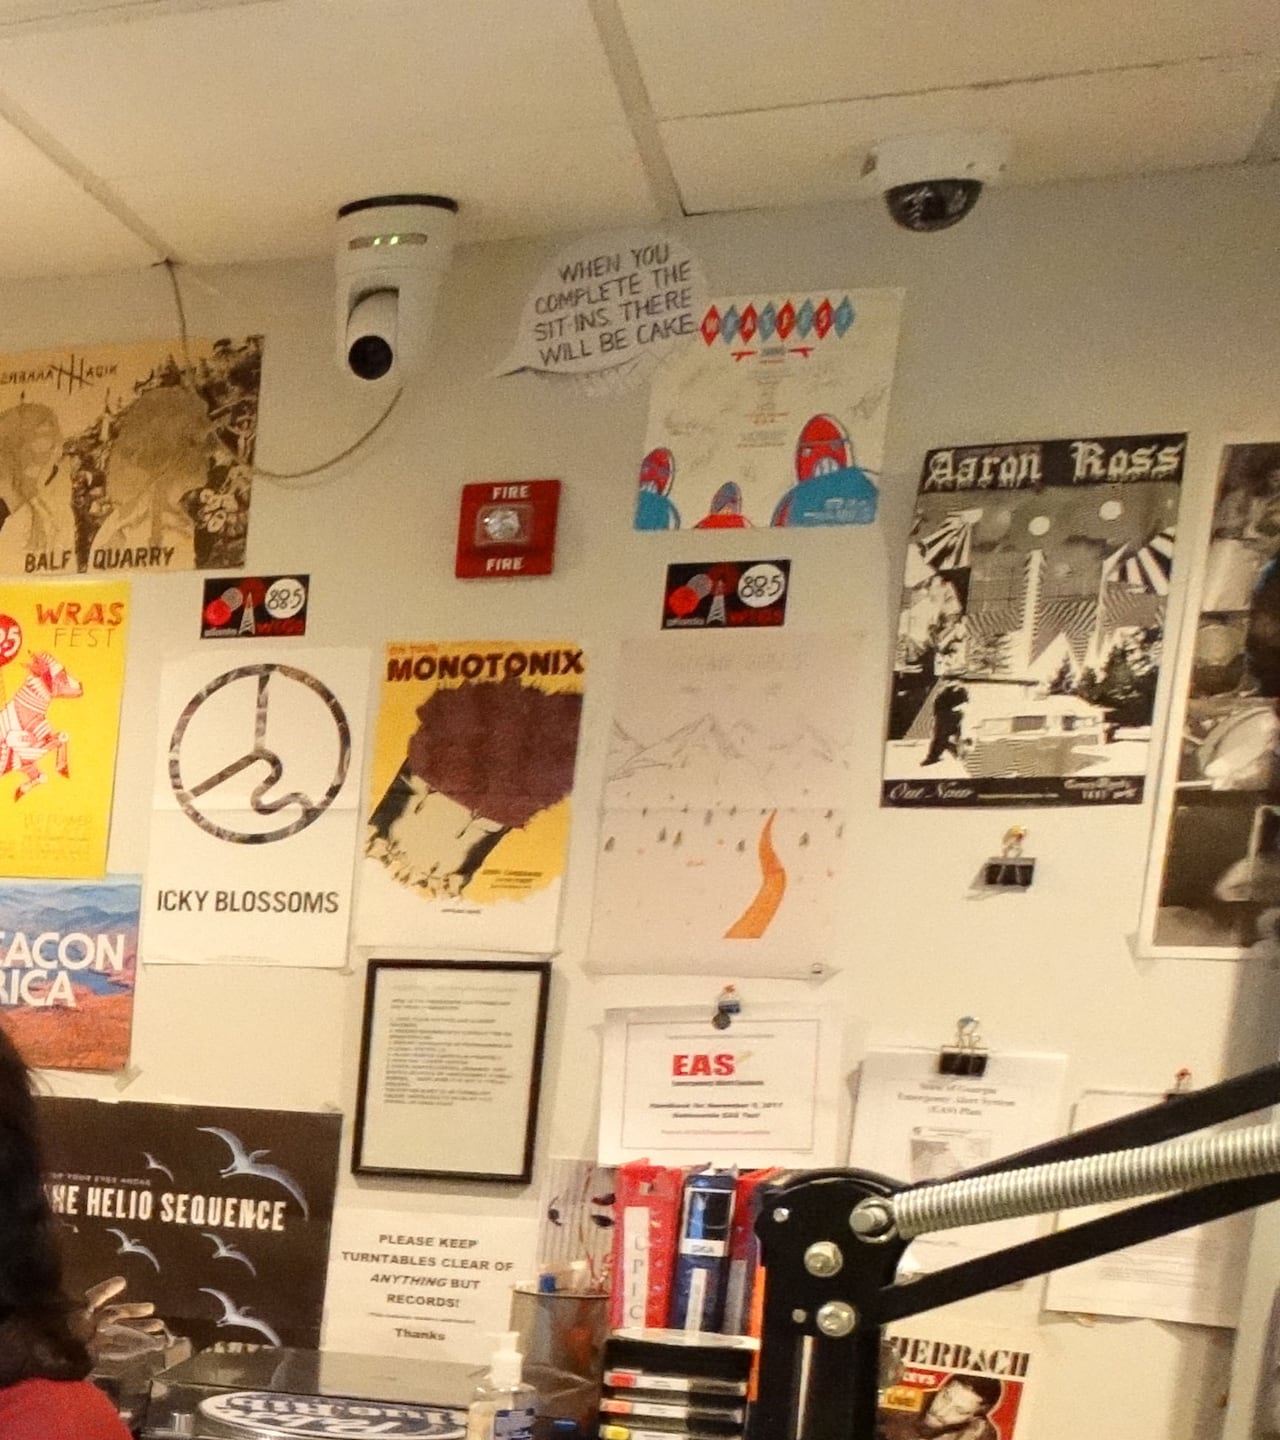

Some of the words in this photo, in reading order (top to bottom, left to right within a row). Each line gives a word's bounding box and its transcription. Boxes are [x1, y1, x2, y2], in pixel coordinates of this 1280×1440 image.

[559, 253, 620, 284] WHEN
[631, 243, 670, 268] YOU
[534, 272, 642, 315] COMPLETE
[651, 259, 691, 289] THE
[619, 287, 693, 322] THERE
[539, 339, 593, 368] WILL
[598, 327, 628, 353] BE
[923, 449, 1043, 493] Aaron
[1070, 439, 1185, 485] Ross
[492, 485, 531, 501] FIRE
[23, 548, 73, 574] BALF
[92, 546, 176, 572] QUARRY
[485, 556, 525, 572] FIRE
[34, 600, 126, 628] WRAS
[52, 626, 117, 650] FEST
[386, 648, 585, 682] MONOTONIX
[156, 889, 210, 914] ICKY
[214, 889, 340, 915] BLOSSOMS
[672, 1053, 736, 1077] EAS
[43, 1183, 81, 1216] HE
[86, 1185, 154, 1222] HELIO
[159, 1192, 288, 1232] SEQUENCE
[377, 1234, 435, 1250] PLEASE
[439, 1236, 479, 1250] KEEP
[340, 1251, 437, 1268] TURNTABLES
[441, 1256, 490, 1271] CLEAR
[494, 1260, 515, 1273] OF
[369, 1273, 448, 1289] ANYTHING
[450, 1277, 481, 1291] BUT
[386, 1293, 461, 1309] RECORDS!
[394, 1327, 447, 1343] Thanks
